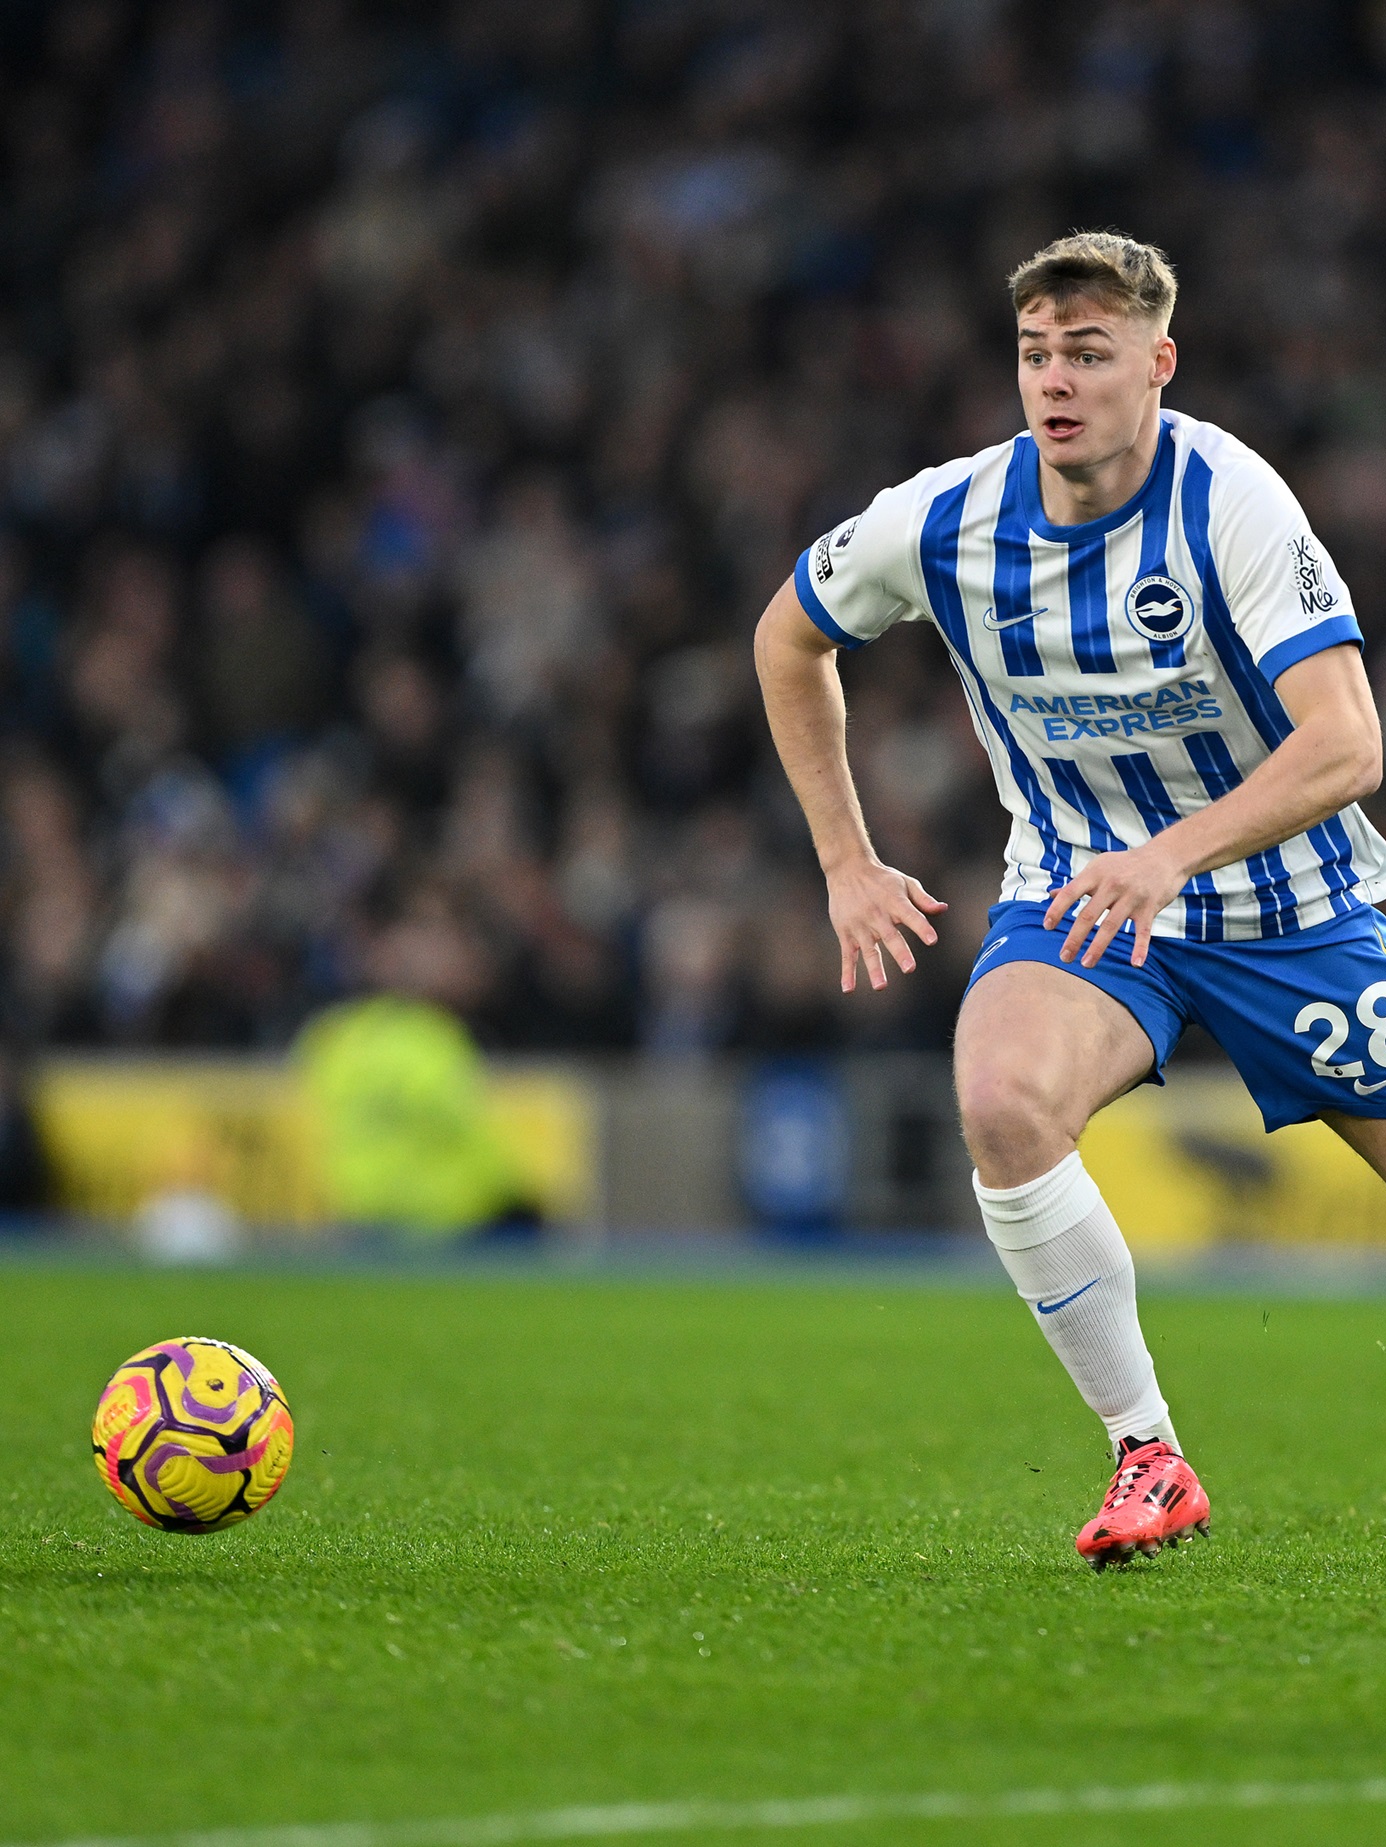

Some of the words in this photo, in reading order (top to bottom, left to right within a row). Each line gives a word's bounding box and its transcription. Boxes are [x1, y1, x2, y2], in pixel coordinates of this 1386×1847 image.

[1130, 577, 1156, 598] BRIGHTON
[1164, 579, 1181, 592] HOVE
[1153, 631, 1178, 639] ALBION
[1010, 680, 1211, 716] AMERICAN
[1043, 698, 1223, 742] EXPRESS
